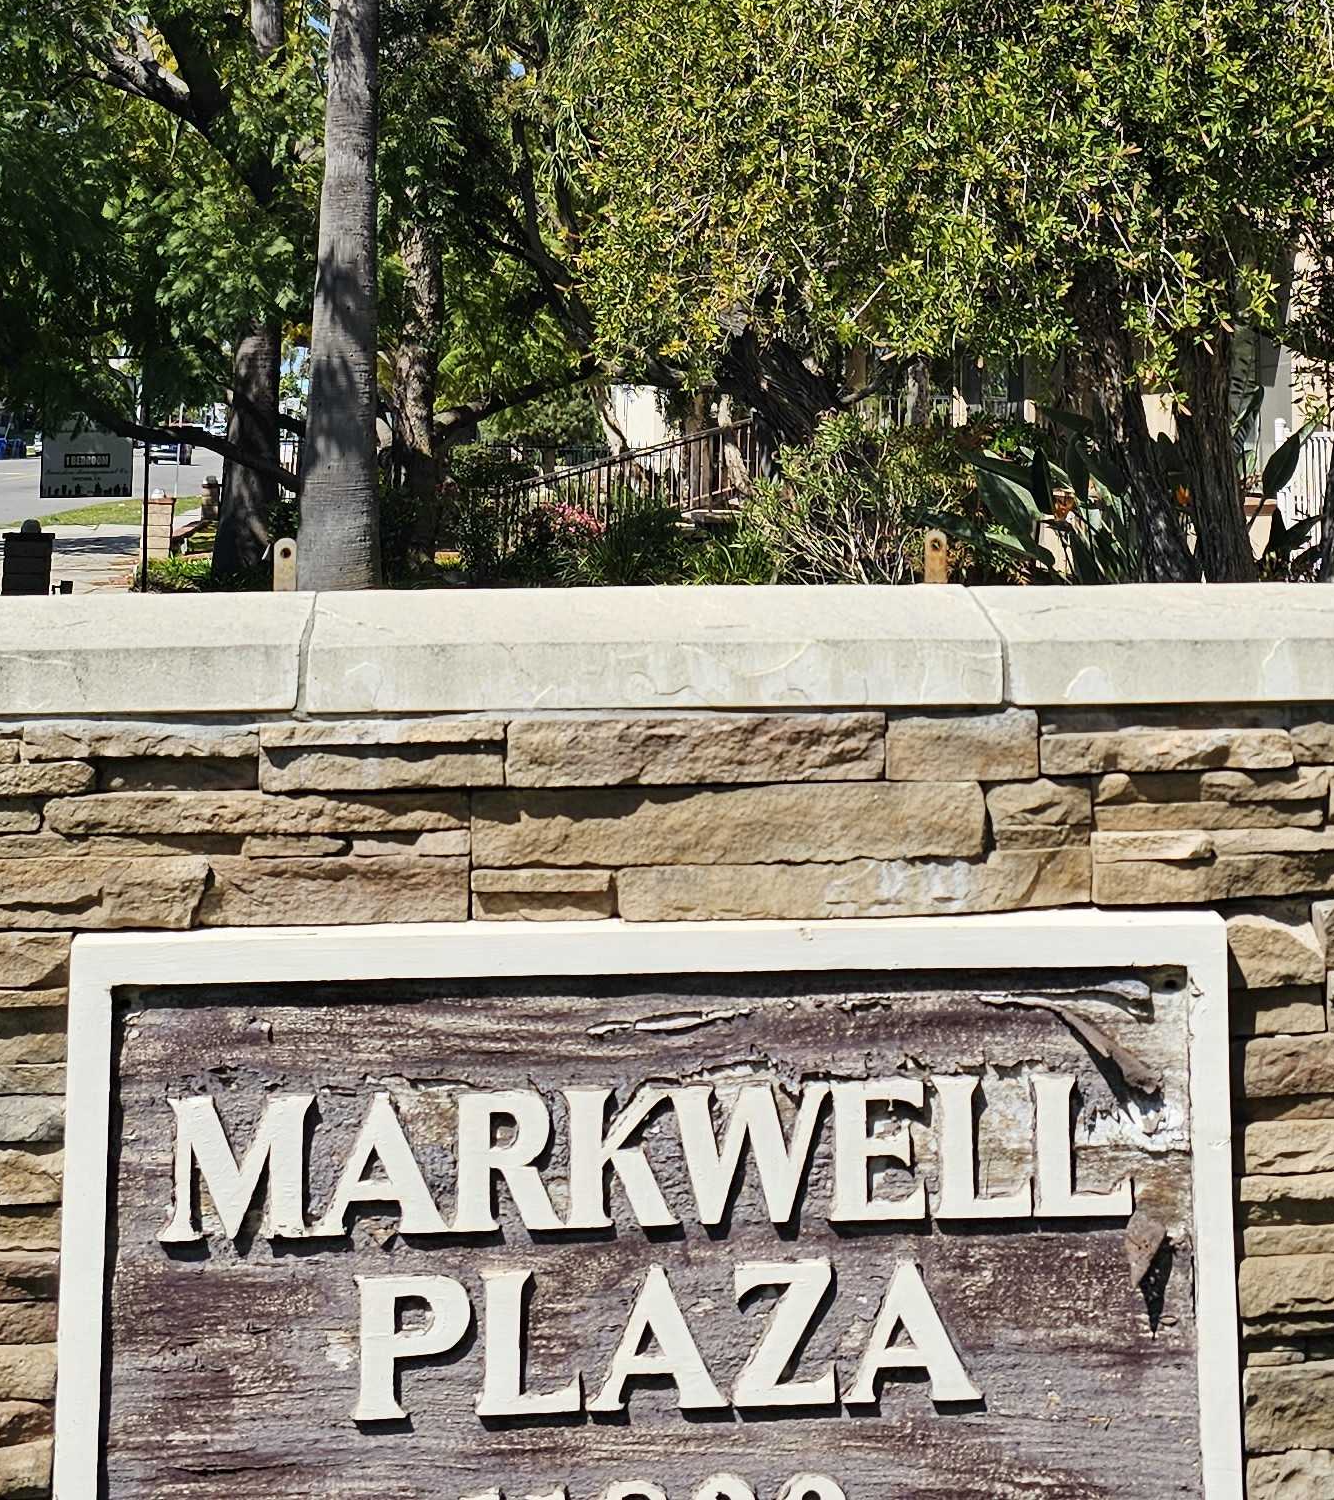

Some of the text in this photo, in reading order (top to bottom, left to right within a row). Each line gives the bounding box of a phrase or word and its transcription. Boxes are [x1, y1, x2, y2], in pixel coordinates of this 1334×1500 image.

[71, 455, 109, 466] BEDROOM
[157, 1074, 1133, 1242] MARKWELL
[351, 1257, 984, 1421] PLAZA
